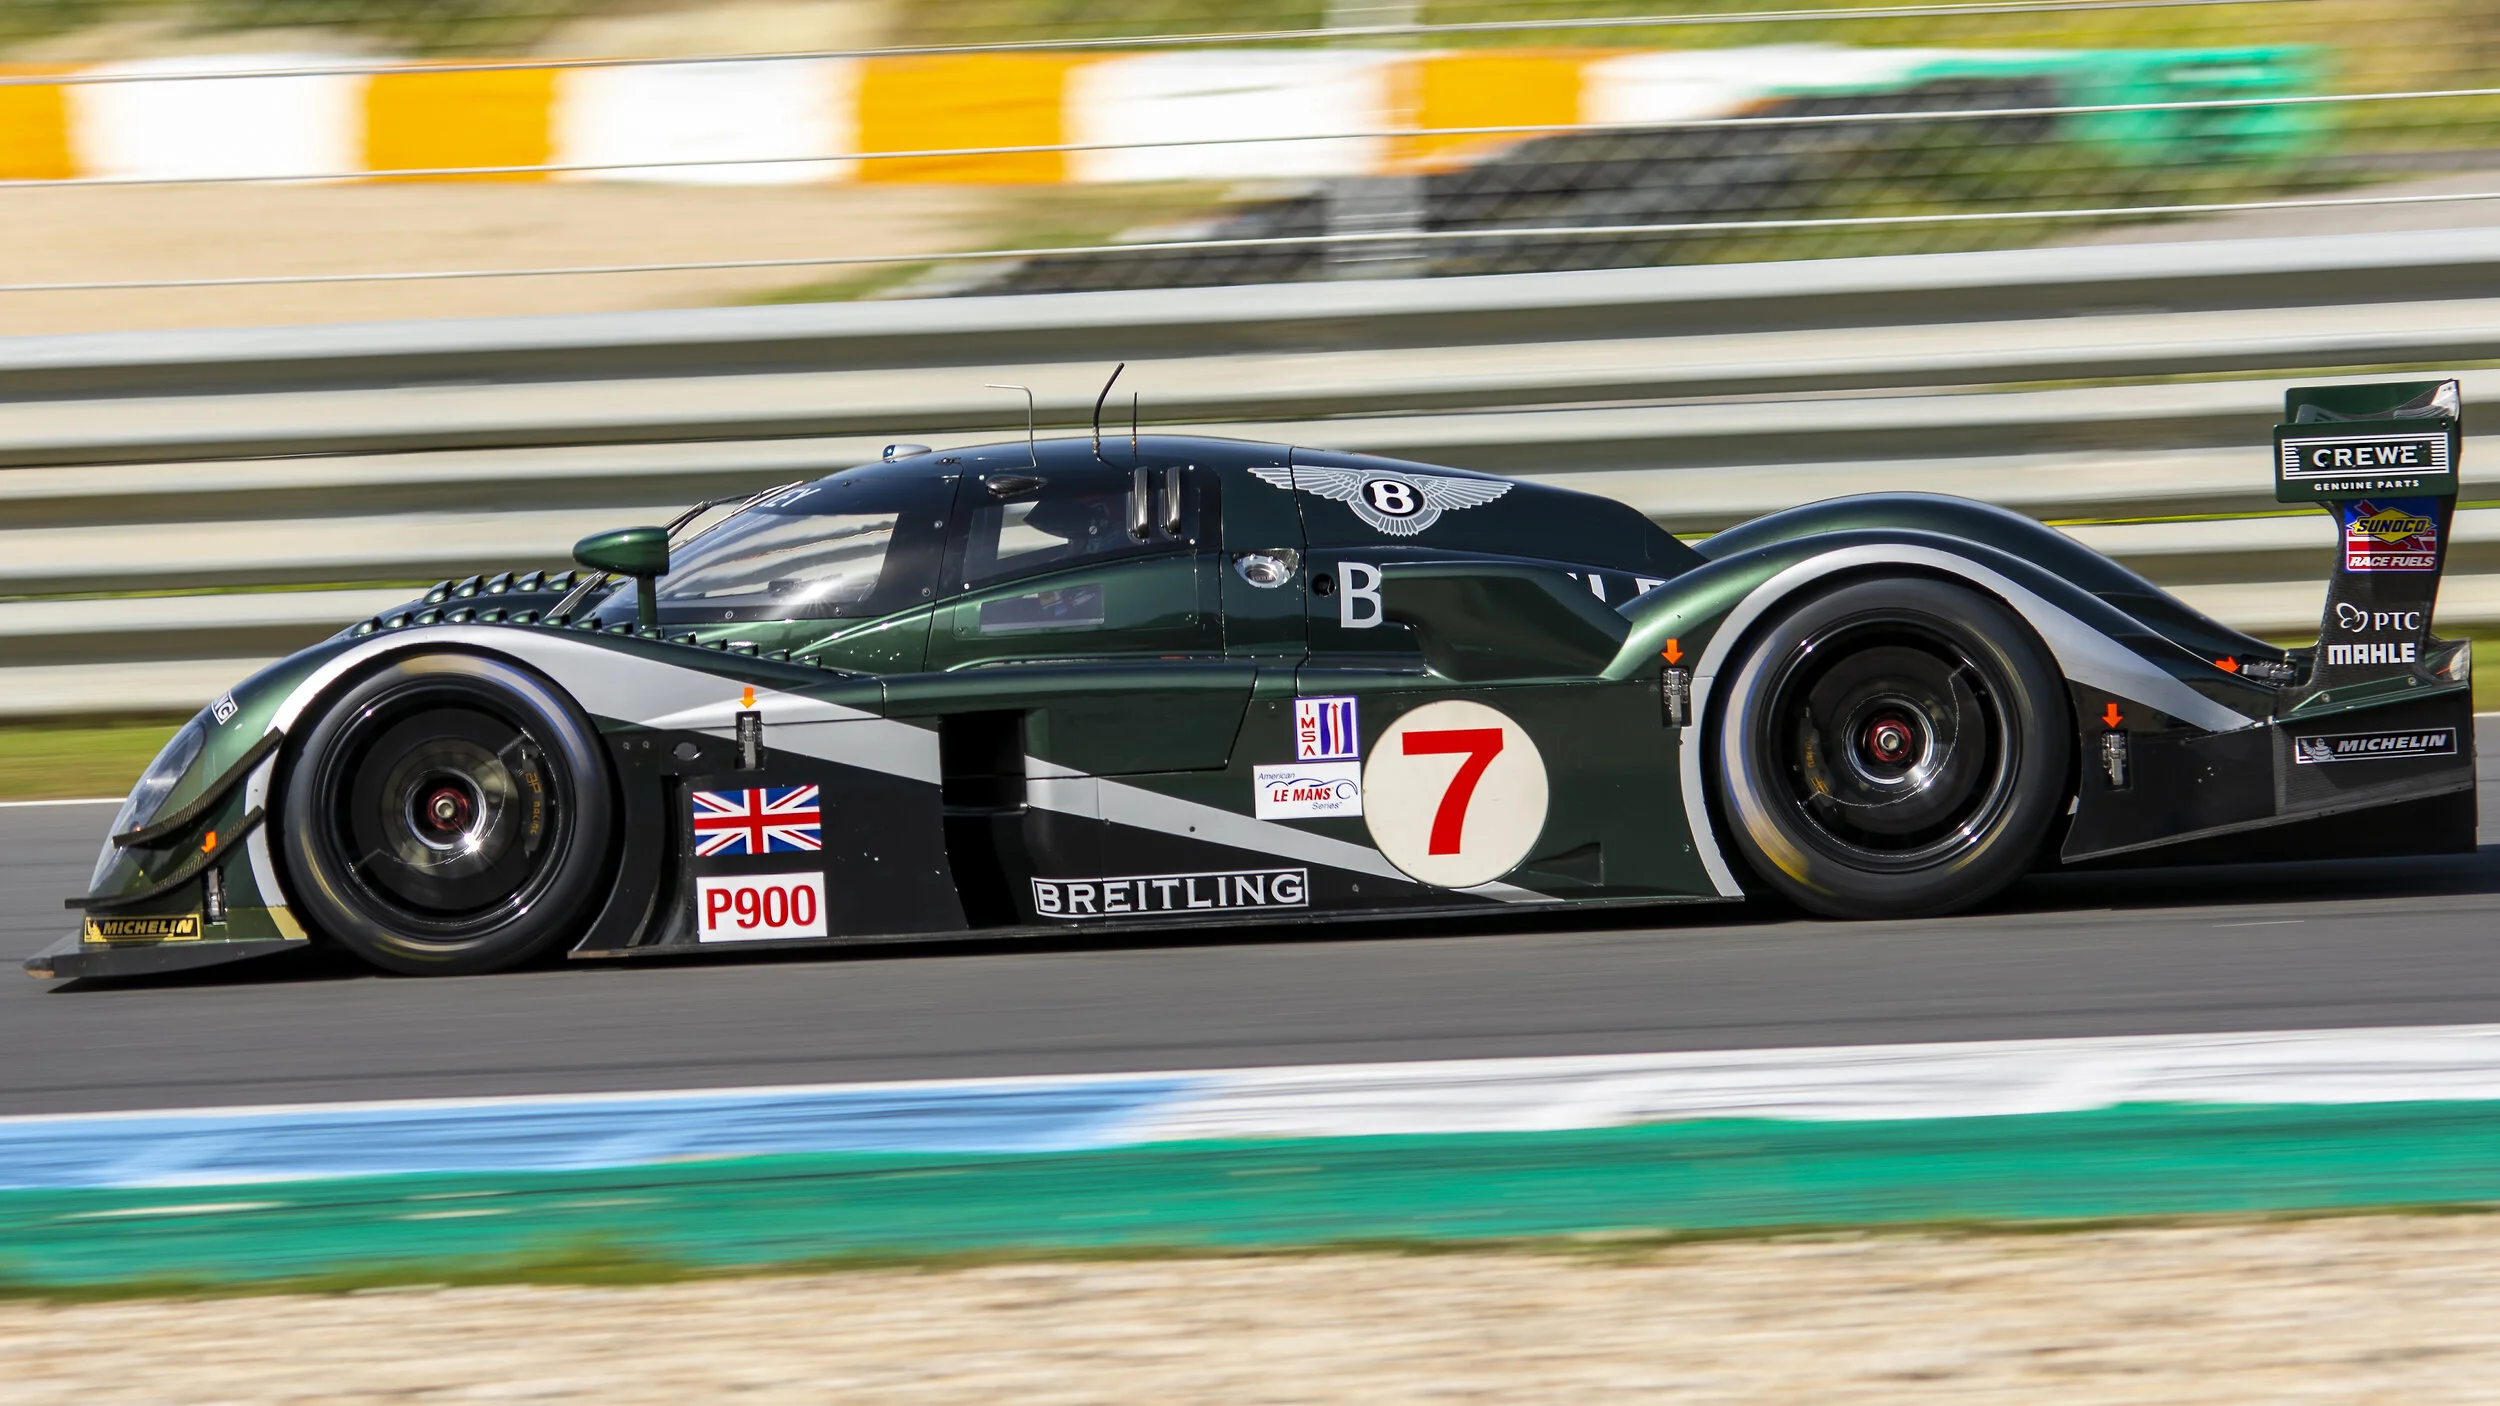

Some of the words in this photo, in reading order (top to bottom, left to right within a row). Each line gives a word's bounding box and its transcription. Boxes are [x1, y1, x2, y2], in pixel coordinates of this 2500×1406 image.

[2312, 445, 2419, 467] CREWE
[2314, 481, 2373, 491] GENUINE
[2377, 479, 2420, 488] PARTS
[1370, 480, 1414, 514] B
[2356, 519, 2427, 533] SUNOCO
[2349, 556, 2390, 567] RACE
[2390, 556, 2435, 567] FUELS
[2373, 611, 2420, 631] PTC
[2328, 642, 2415, 665] MAHLE
[1301, 703, 1316, 757] IMSA
[2337, 734, 2447, 753] MICHELIN
[1258, 771, 1296, 780] American
[1273, 789, 1289, 803] LE
[1293, 787, 1332, 802] MANS
[1402, 728, 1504, 856] 7
[1312, 801, 1340, 811] Series
[1036, 873, 1304, 914] BREITLING
[706, 884, 817, 931] P900
[103, 919, 193, 935] MICHELIN
